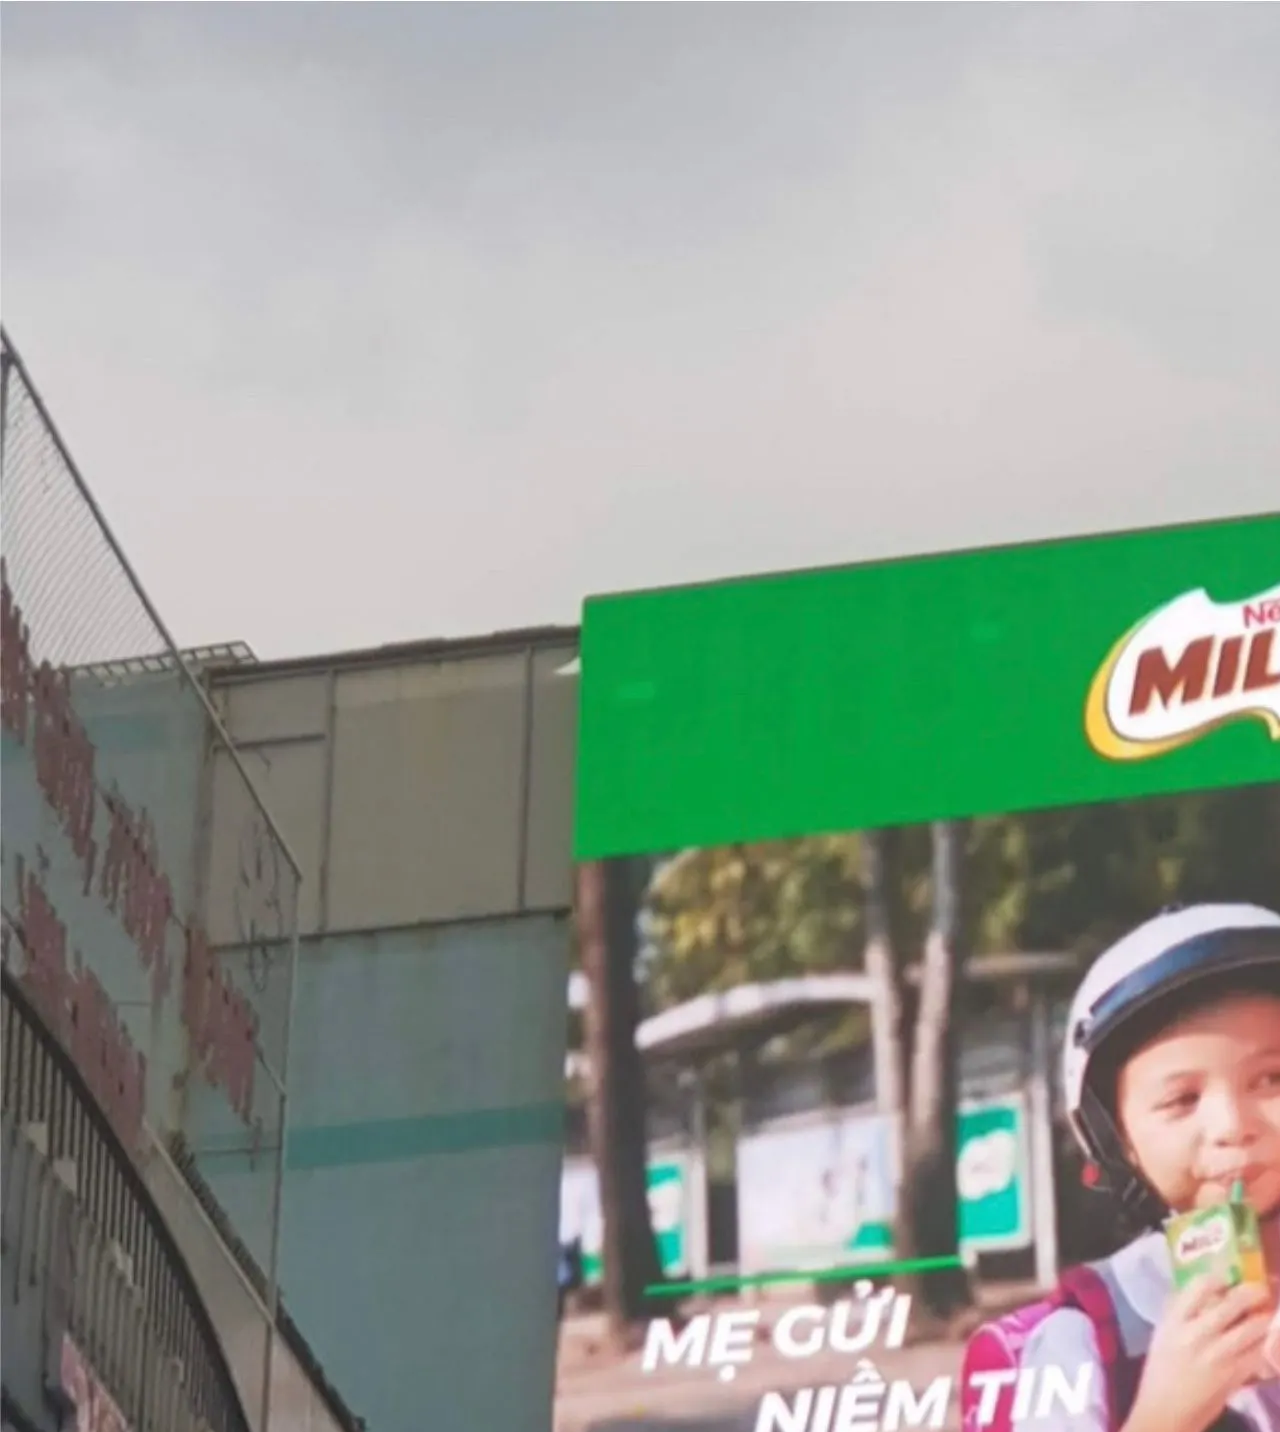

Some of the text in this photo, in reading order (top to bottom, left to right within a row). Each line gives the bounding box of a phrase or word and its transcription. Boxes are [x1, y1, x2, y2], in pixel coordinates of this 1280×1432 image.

[642, 1279, 912, 1382] MẸ GỬI
[970, 1361, 1093, 1425] TIN
